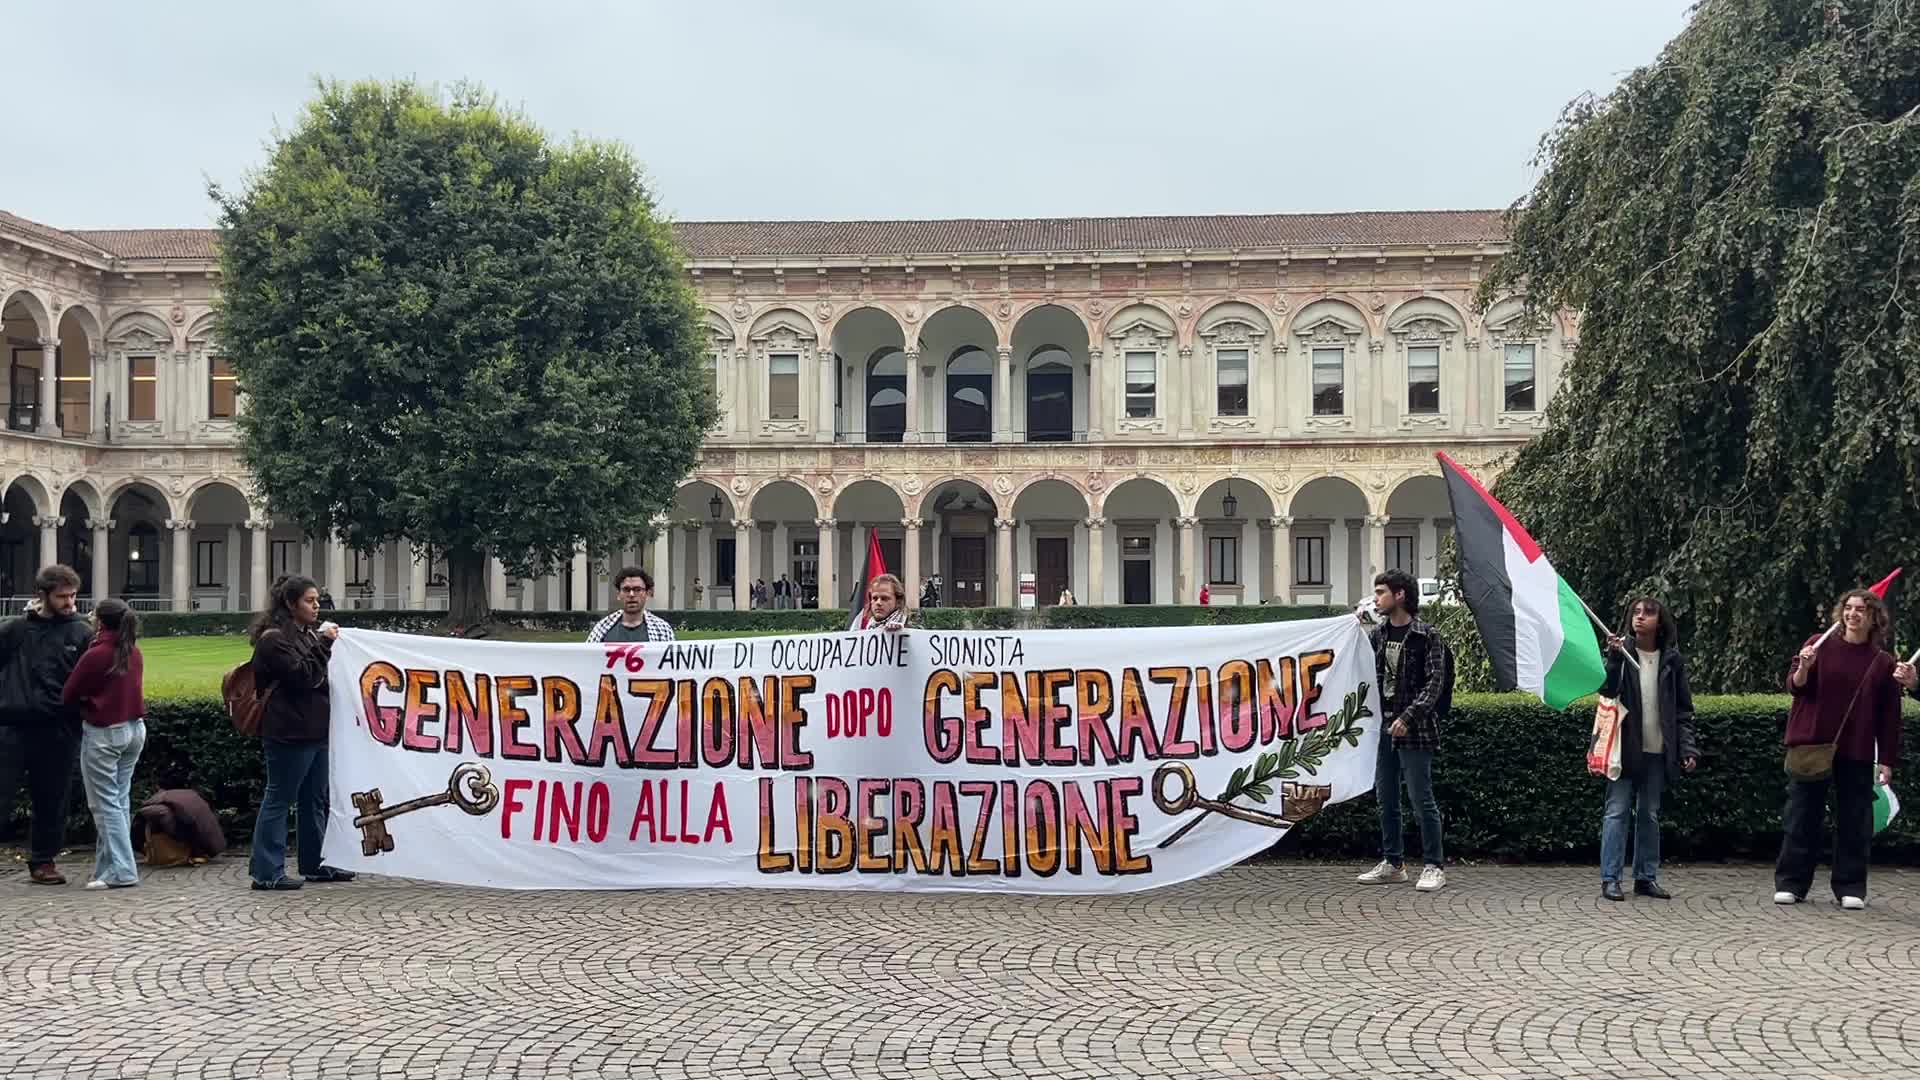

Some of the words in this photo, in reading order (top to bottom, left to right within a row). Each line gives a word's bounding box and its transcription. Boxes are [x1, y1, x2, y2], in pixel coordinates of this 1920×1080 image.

[606, 644, 644, 672] 76
[658, 644, 714, 670] ANNI
[734, 642, 757, 668] DI
[771, 635, 909, 671] OCCUPAZIONE
[931, 635, 1024, 667] SIONISTA
[359, 661, 817, 770] GENERAZIONE
[825, 688, 893, 738] DOPO
[923, 650, 1334, 766] GENERAZIONE
[502, 779, 609, 843] FINO
[630, 779, 733, 844] ALLA
[757, 776, 1152, 876] LIBERAZIONE
